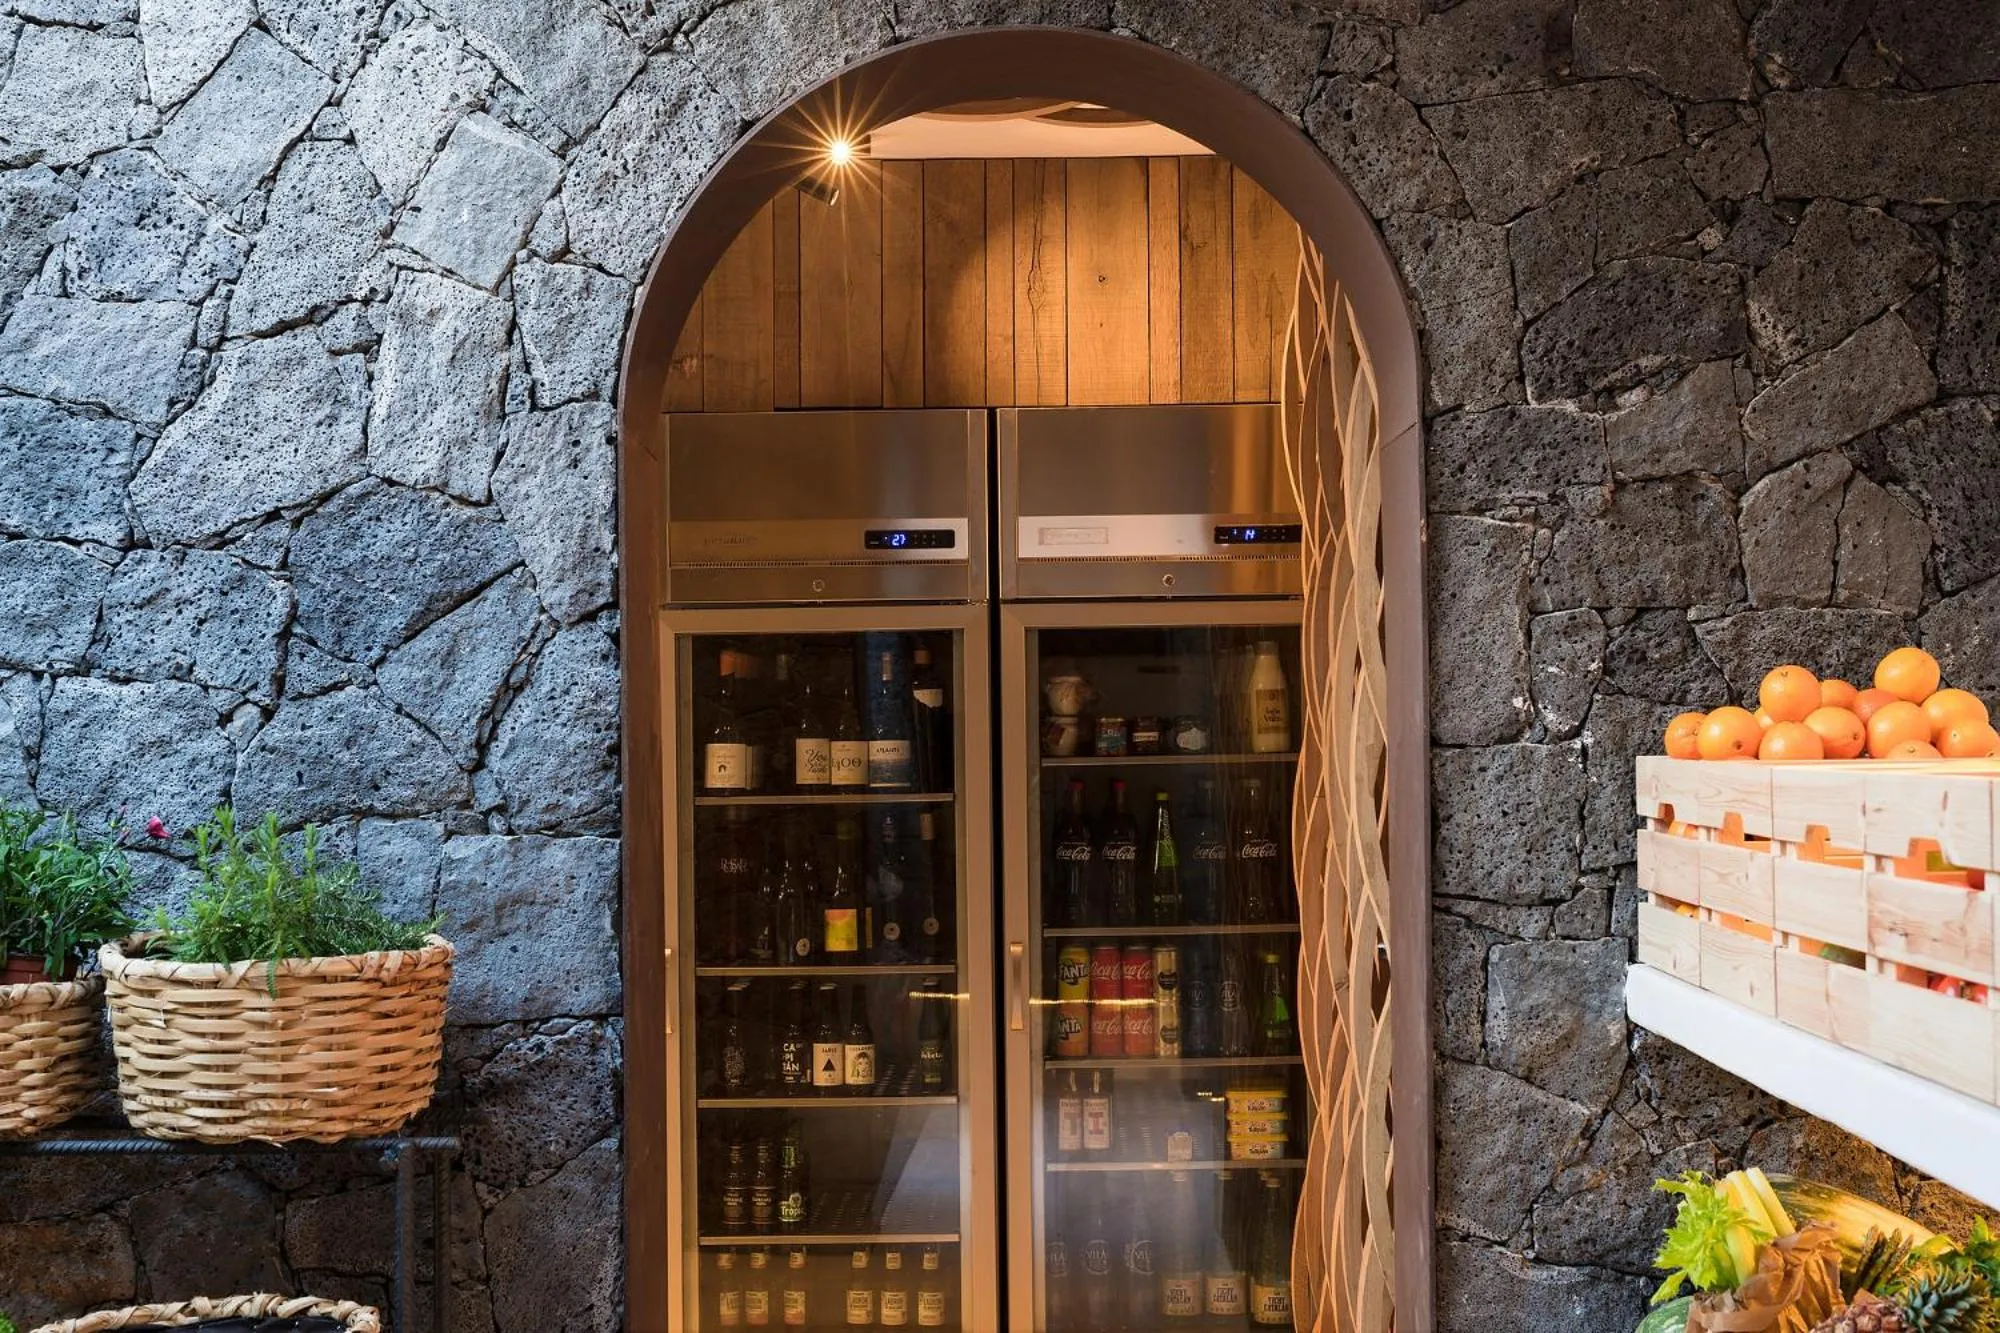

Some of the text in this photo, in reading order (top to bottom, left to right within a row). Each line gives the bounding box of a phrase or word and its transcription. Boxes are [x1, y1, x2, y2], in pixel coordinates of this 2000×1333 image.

[891, 533, 906, 546] 27
[1056, 845, 1091, 861] Coca-Cola
[1102, 845, 1136, 860] Coca-Cola
[1242, 843, 1278, 859] Coca-Cola
